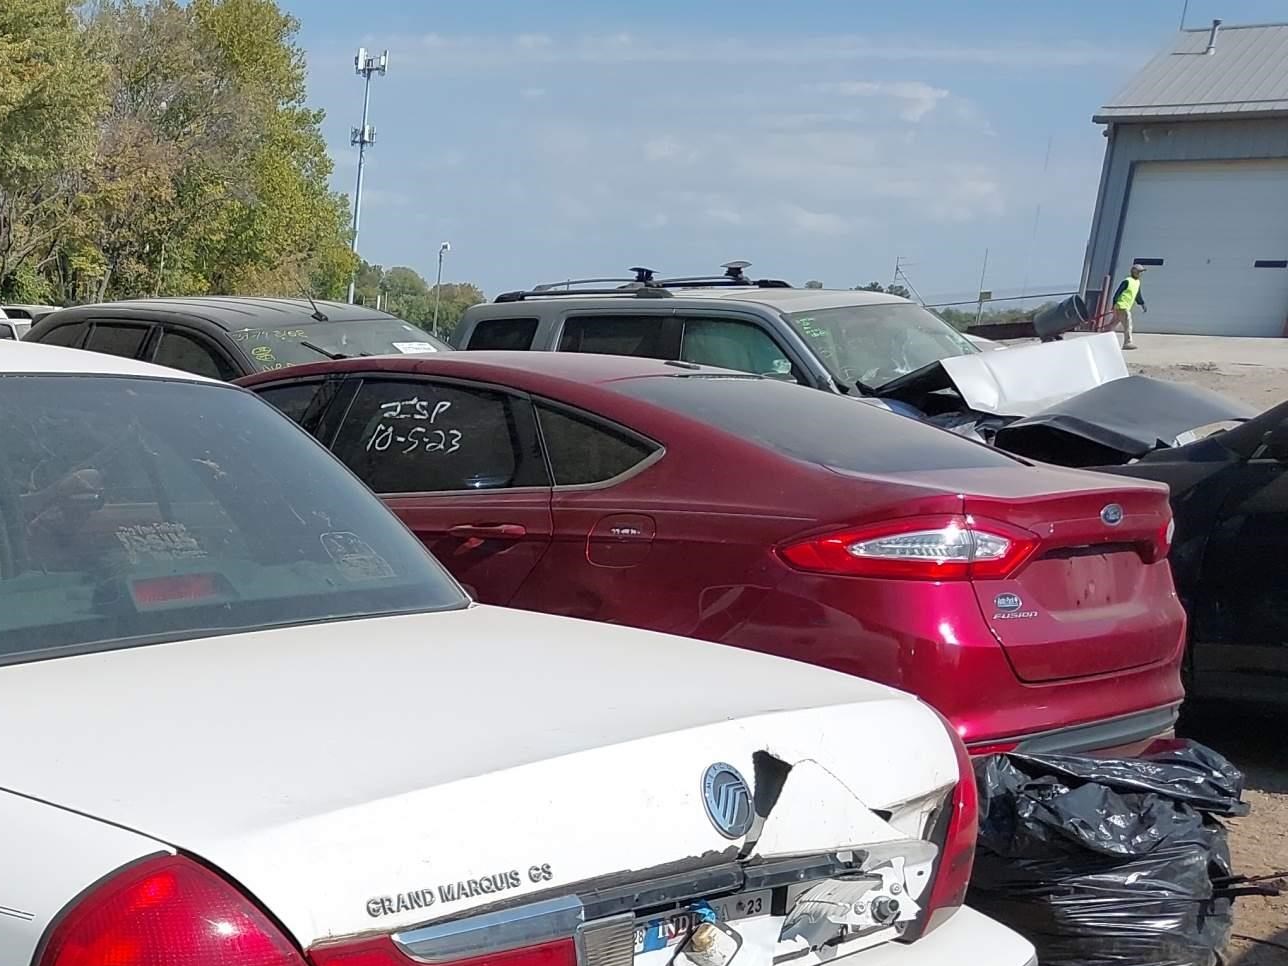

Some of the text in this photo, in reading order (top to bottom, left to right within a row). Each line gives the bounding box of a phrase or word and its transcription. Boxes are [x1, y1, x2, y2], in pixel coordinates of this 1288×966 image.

[366, 863, 554, 918] GRAND MARQUIS GS
[746, 898, 762, 915] 23
[657, 903, 730, 939] INDIA
